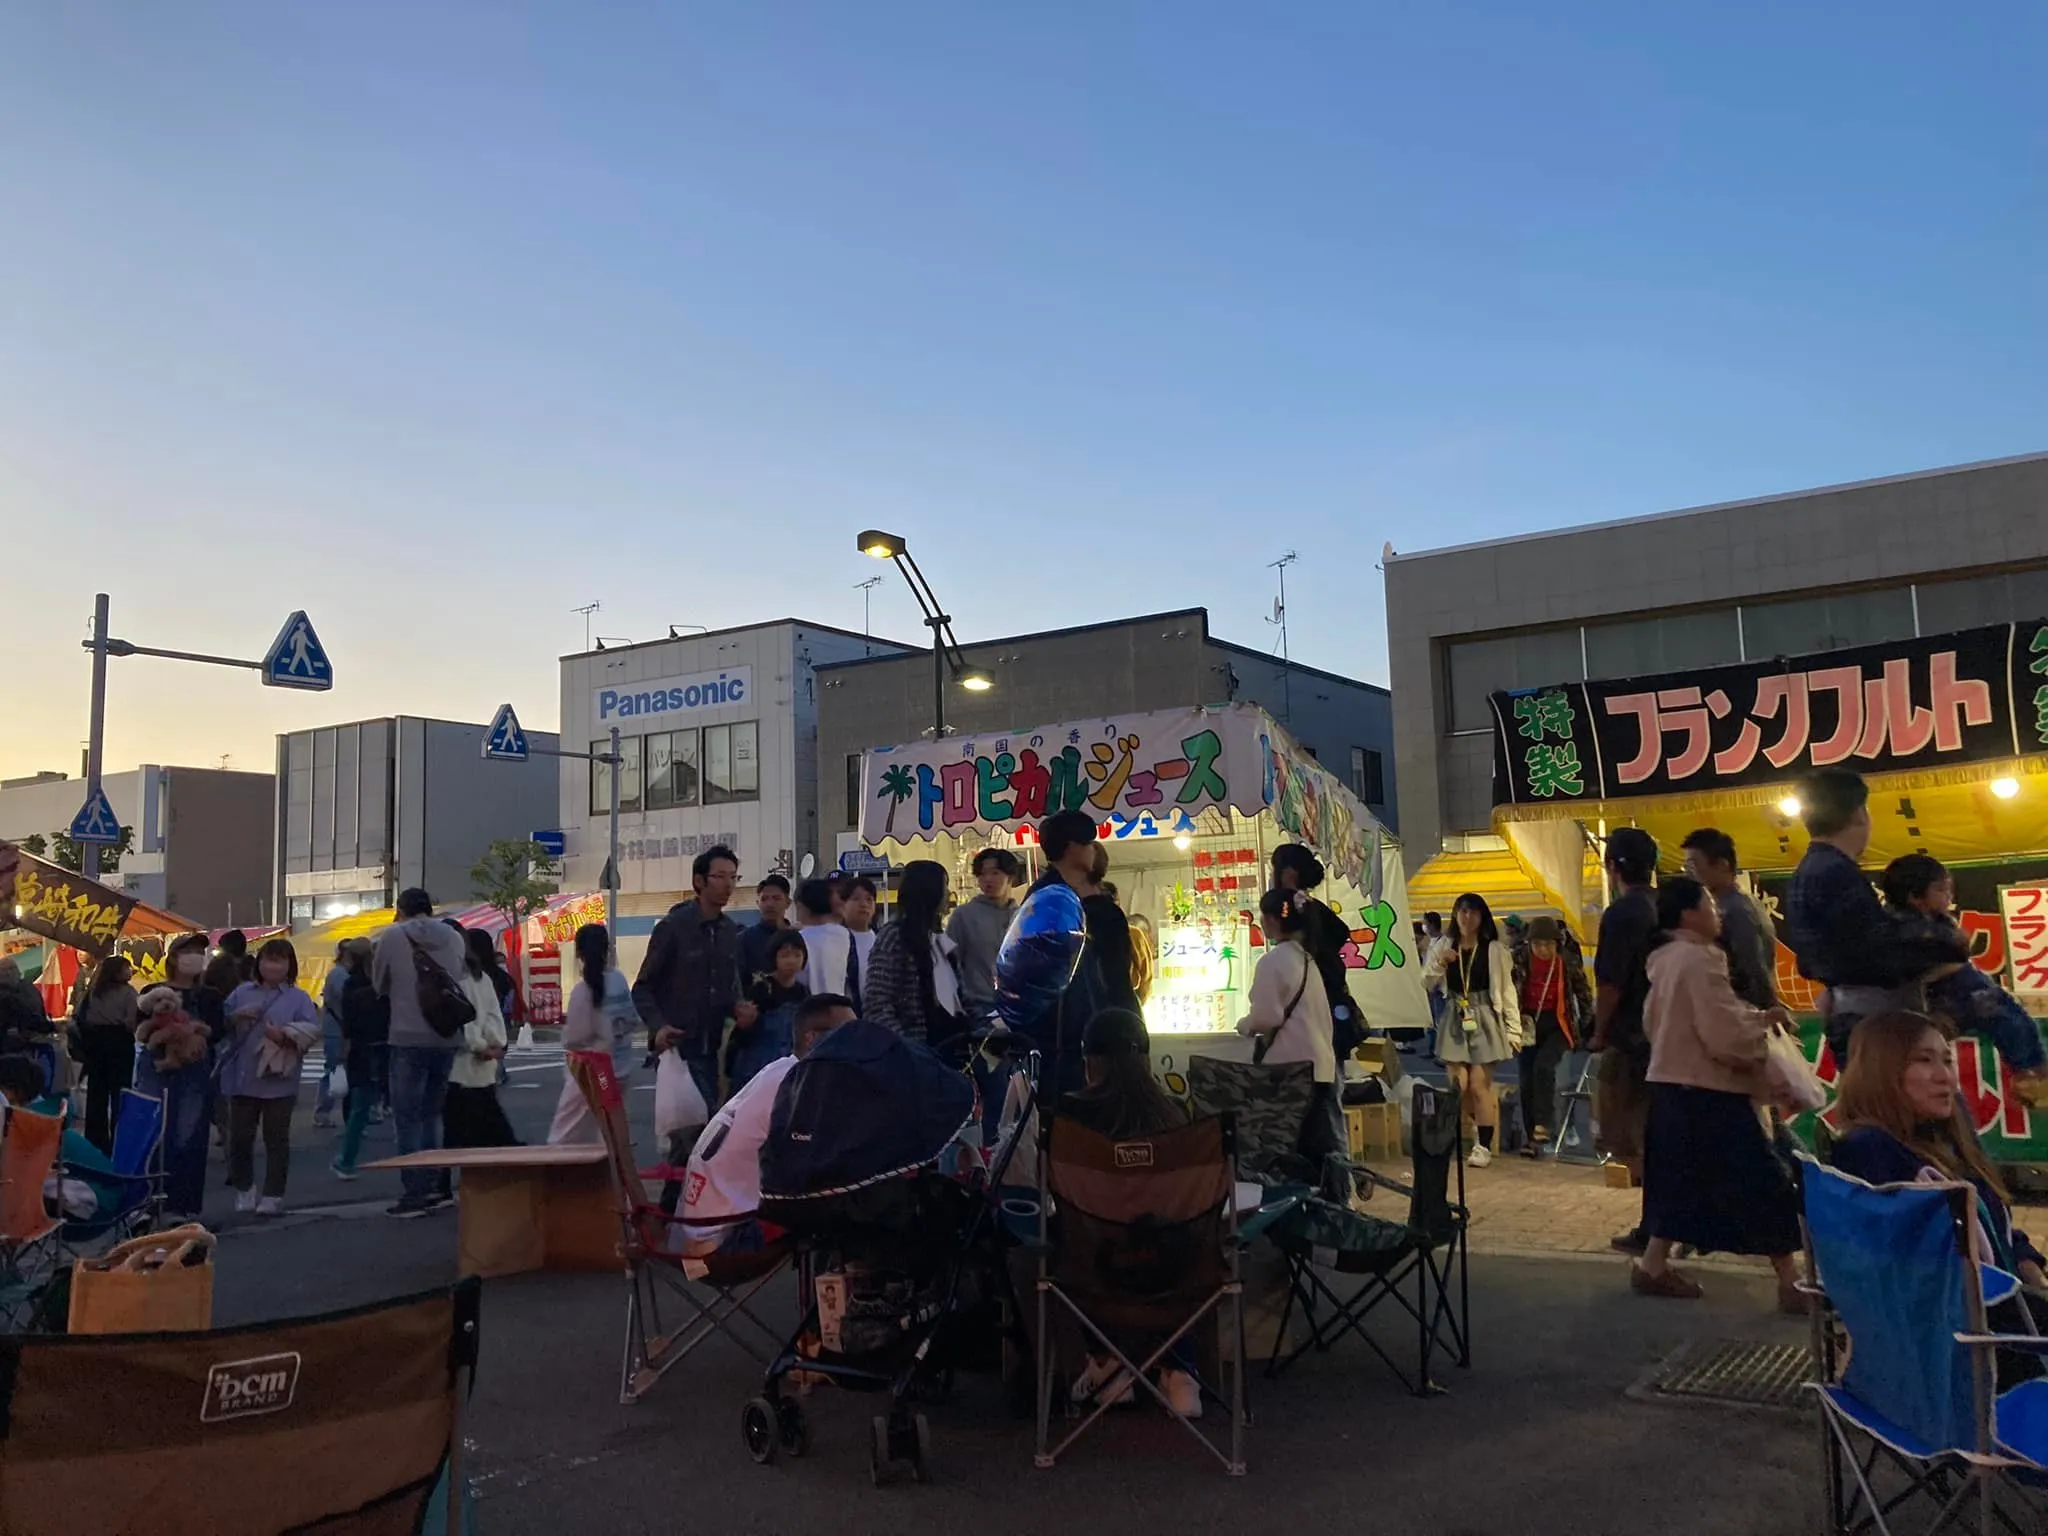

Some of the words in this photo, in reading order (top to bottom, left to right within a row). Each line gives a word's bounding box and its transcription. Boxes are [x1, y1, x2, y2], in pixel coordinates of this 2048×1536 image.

[600, 673, 744, 719] Panasonic
[1605, 651, 1994, 784] フランクフルト
[963, 724, 1117, 757] 南国の香り
[1514, 688, 1584, 798] 特製
[916, 729, 1227, 829] トロピカルジュース
[1162, 940, 1217, 958] ジュース
[1205, 995, 1214, 1031] コーラ
[1216, 994, 1226, 1031] オレンジ
